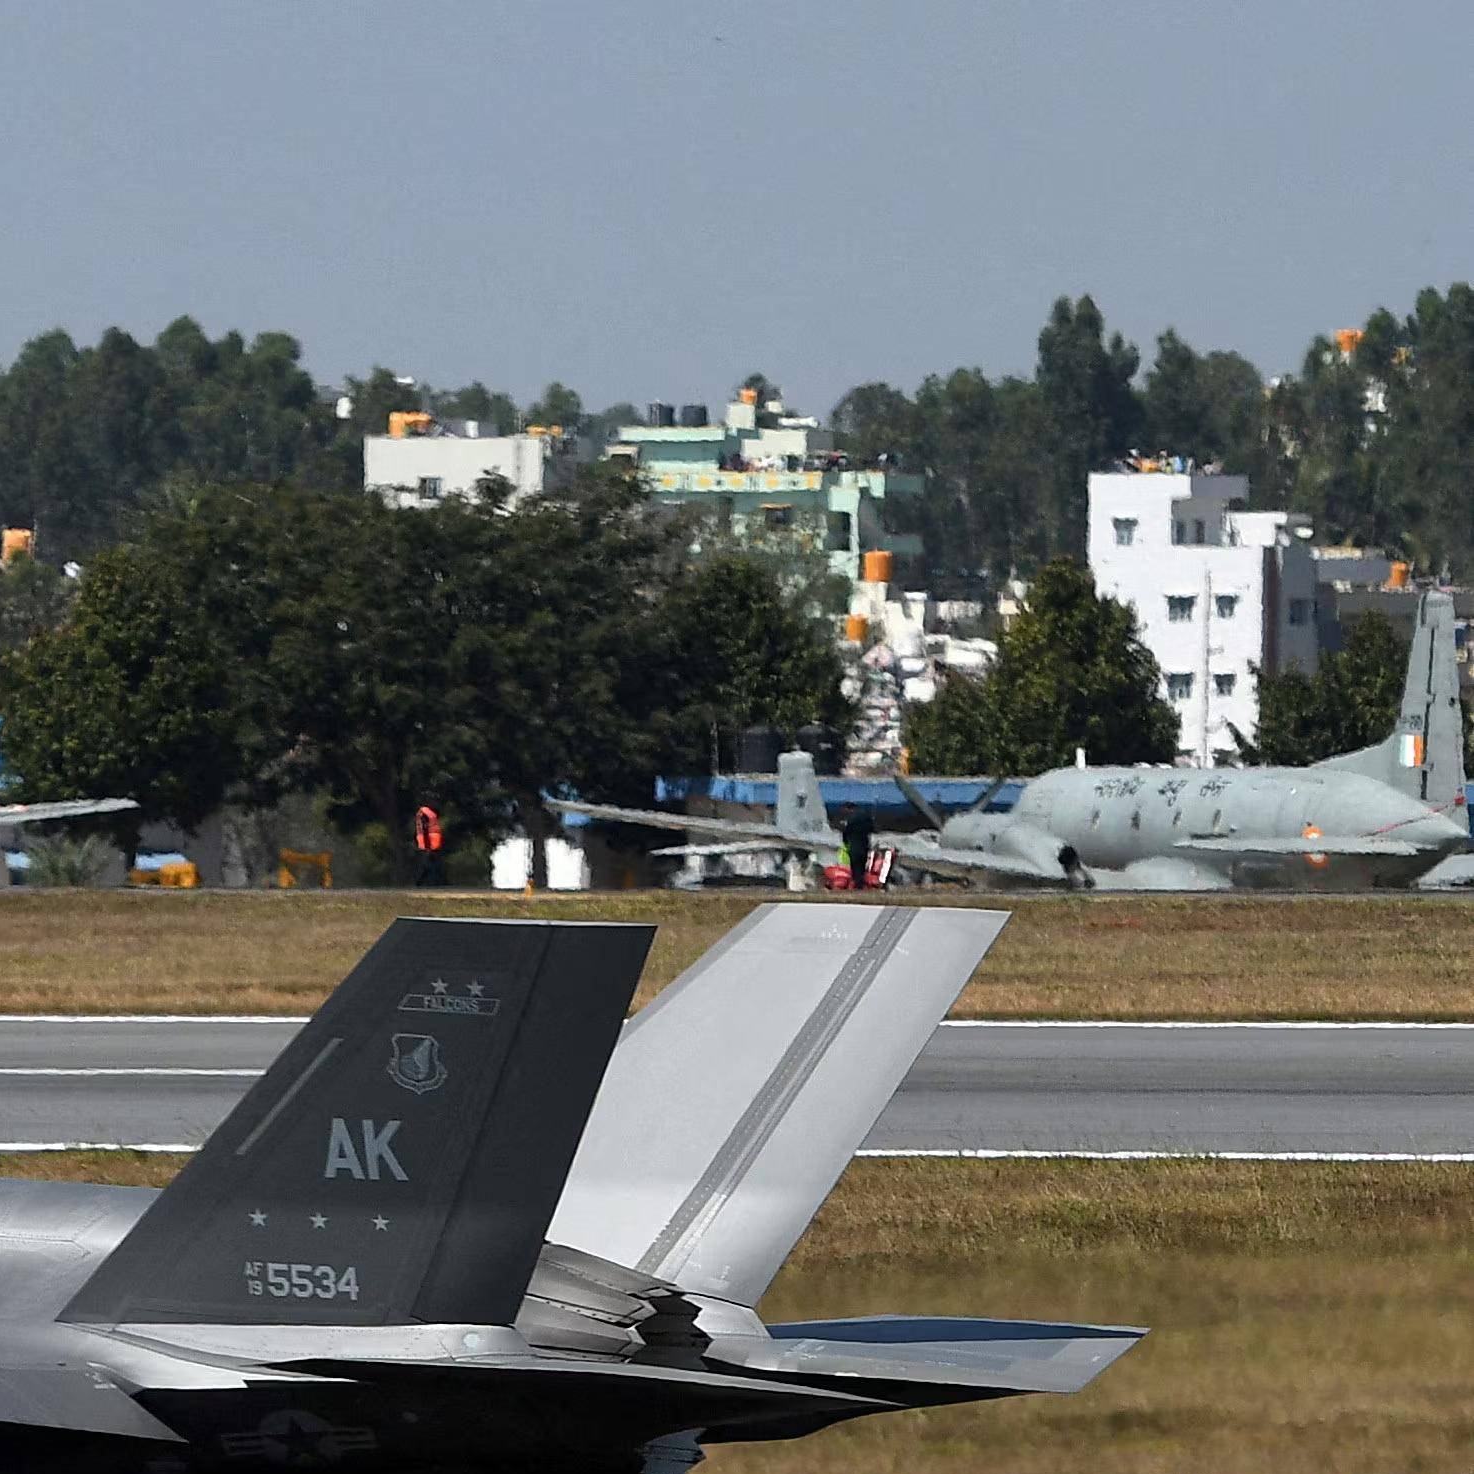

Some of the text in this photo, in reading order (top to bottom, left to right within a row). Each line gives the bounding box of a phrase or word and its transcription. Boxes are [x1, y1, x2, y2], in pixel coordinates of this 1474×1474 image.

[324, 1117, 409, 1181] AK
[244, 1261, 263, 1277] AF
[267, 1262, 359, 1300] 5534
